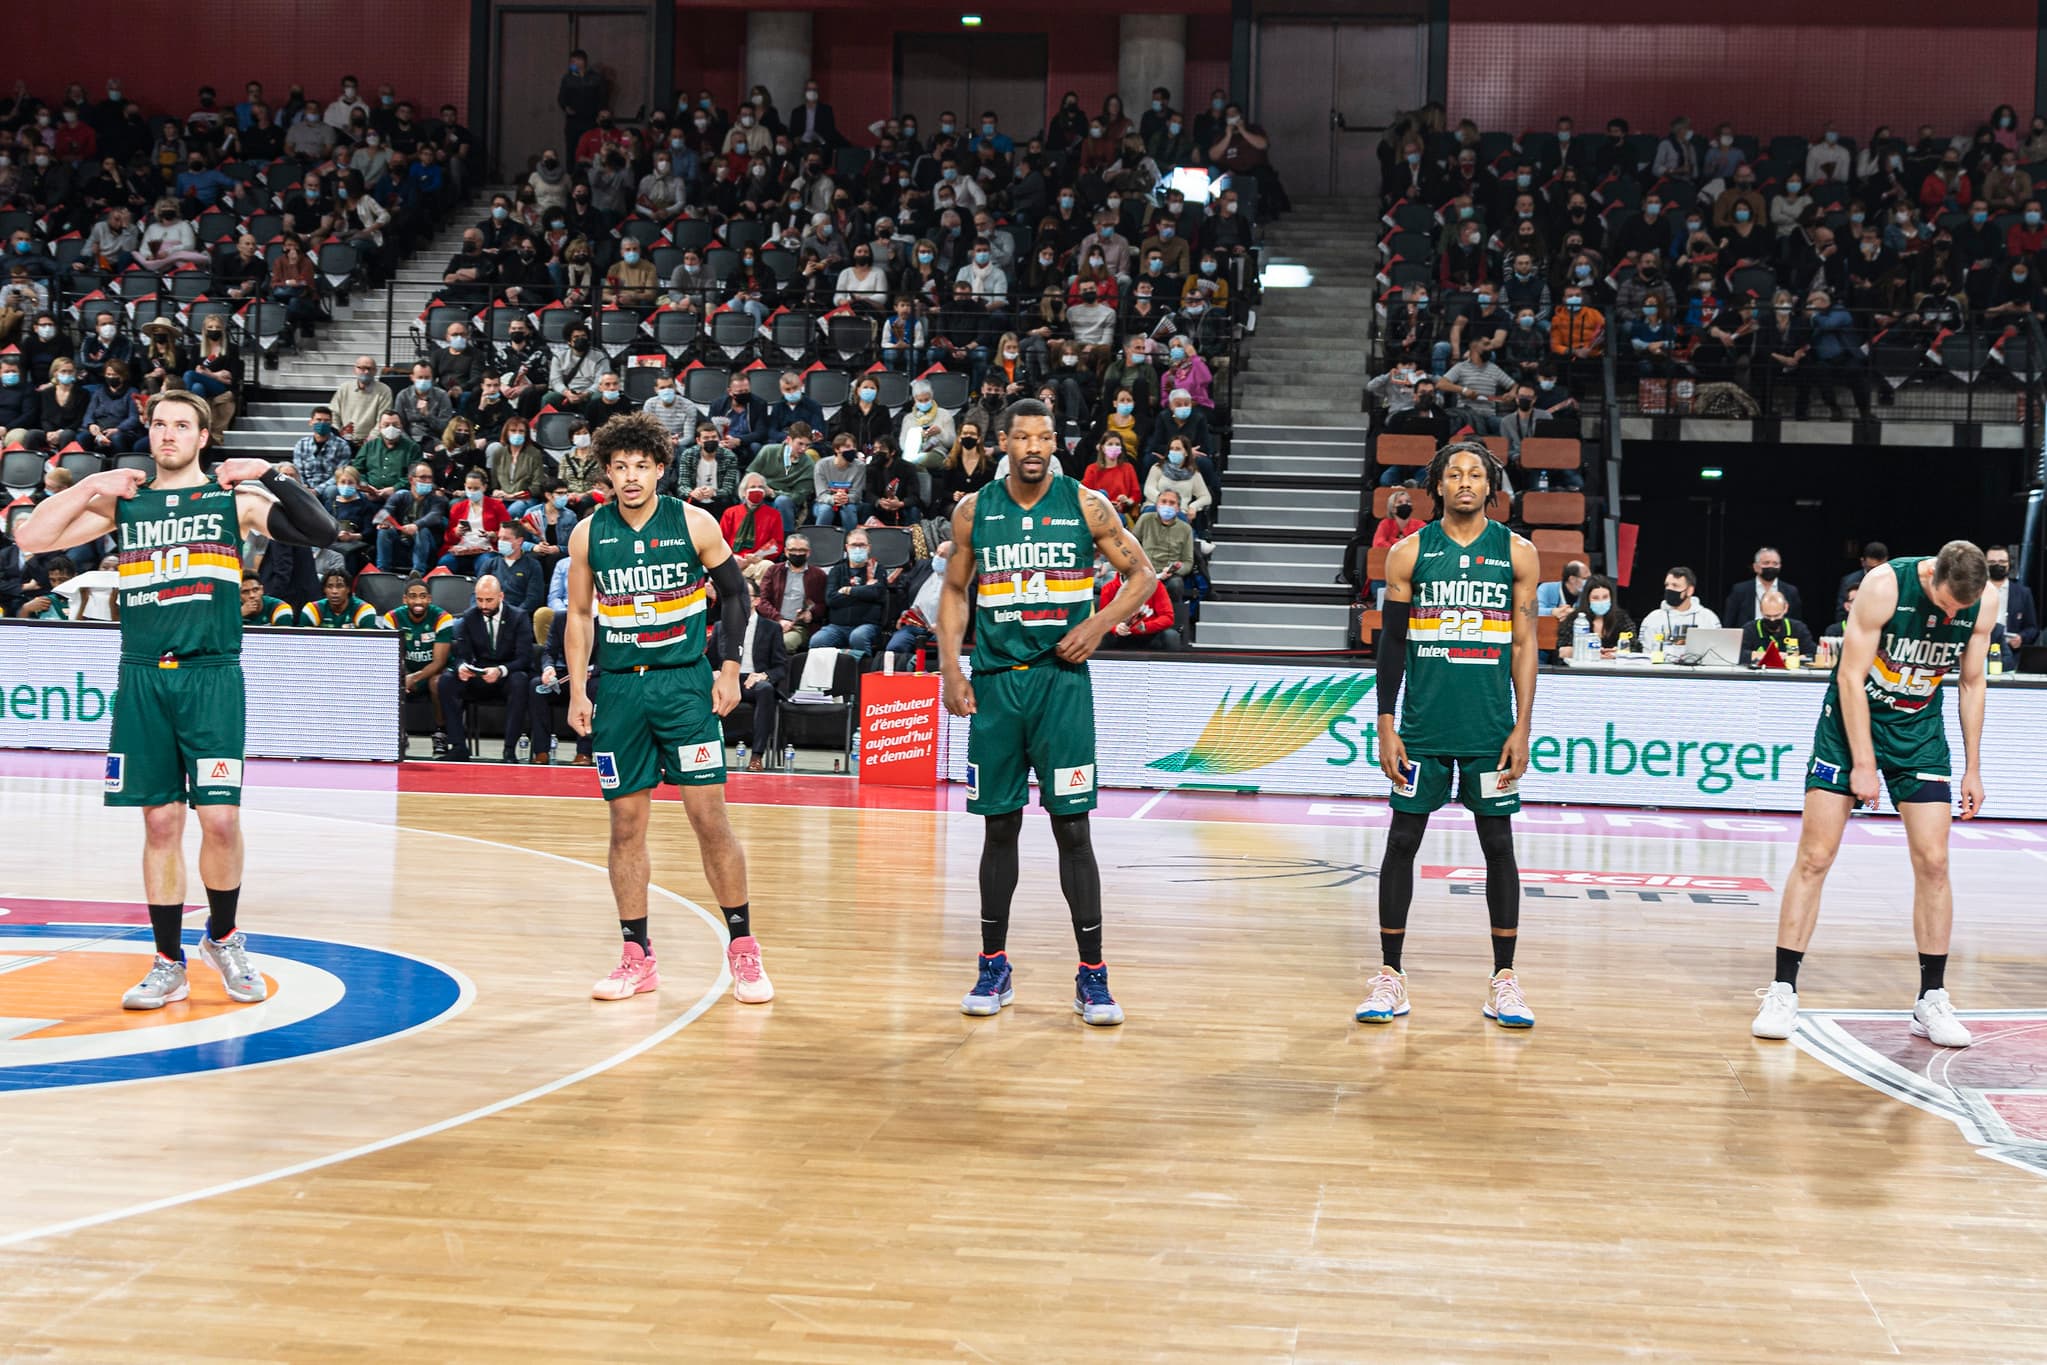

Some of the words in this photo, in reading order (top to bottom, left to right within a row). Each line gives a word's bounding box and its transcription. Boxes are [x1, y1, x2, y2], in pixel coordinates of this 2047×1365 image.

[120, 513, 224, 550] LIMOGES
[149, 546, 189, 585] 10
[982, 542, 1077, 572] LIMOGES
[596, 562, 689, 595] LIMOGES
[1010, 571, 1050, 605] 14
[1419, 580, 1508, 609] LIMOGES
[633, 594, 658, 626] 5
[1438, 609, 1484, 642] 22
[0, 671, 119, 722] enb
[1891, 666, 1937, 697] 15
[865, 697, 935, 717] Distributeur
[869, 714, 930, 732] d'énergies
[865, 728, 934, 751] aujourd'hui
[866, 753, 878, 765] et
[879, 748, 925, 763] demain
[926, 744, 932, 756] !
[1325, 713, 1793, 794] Stenberger
